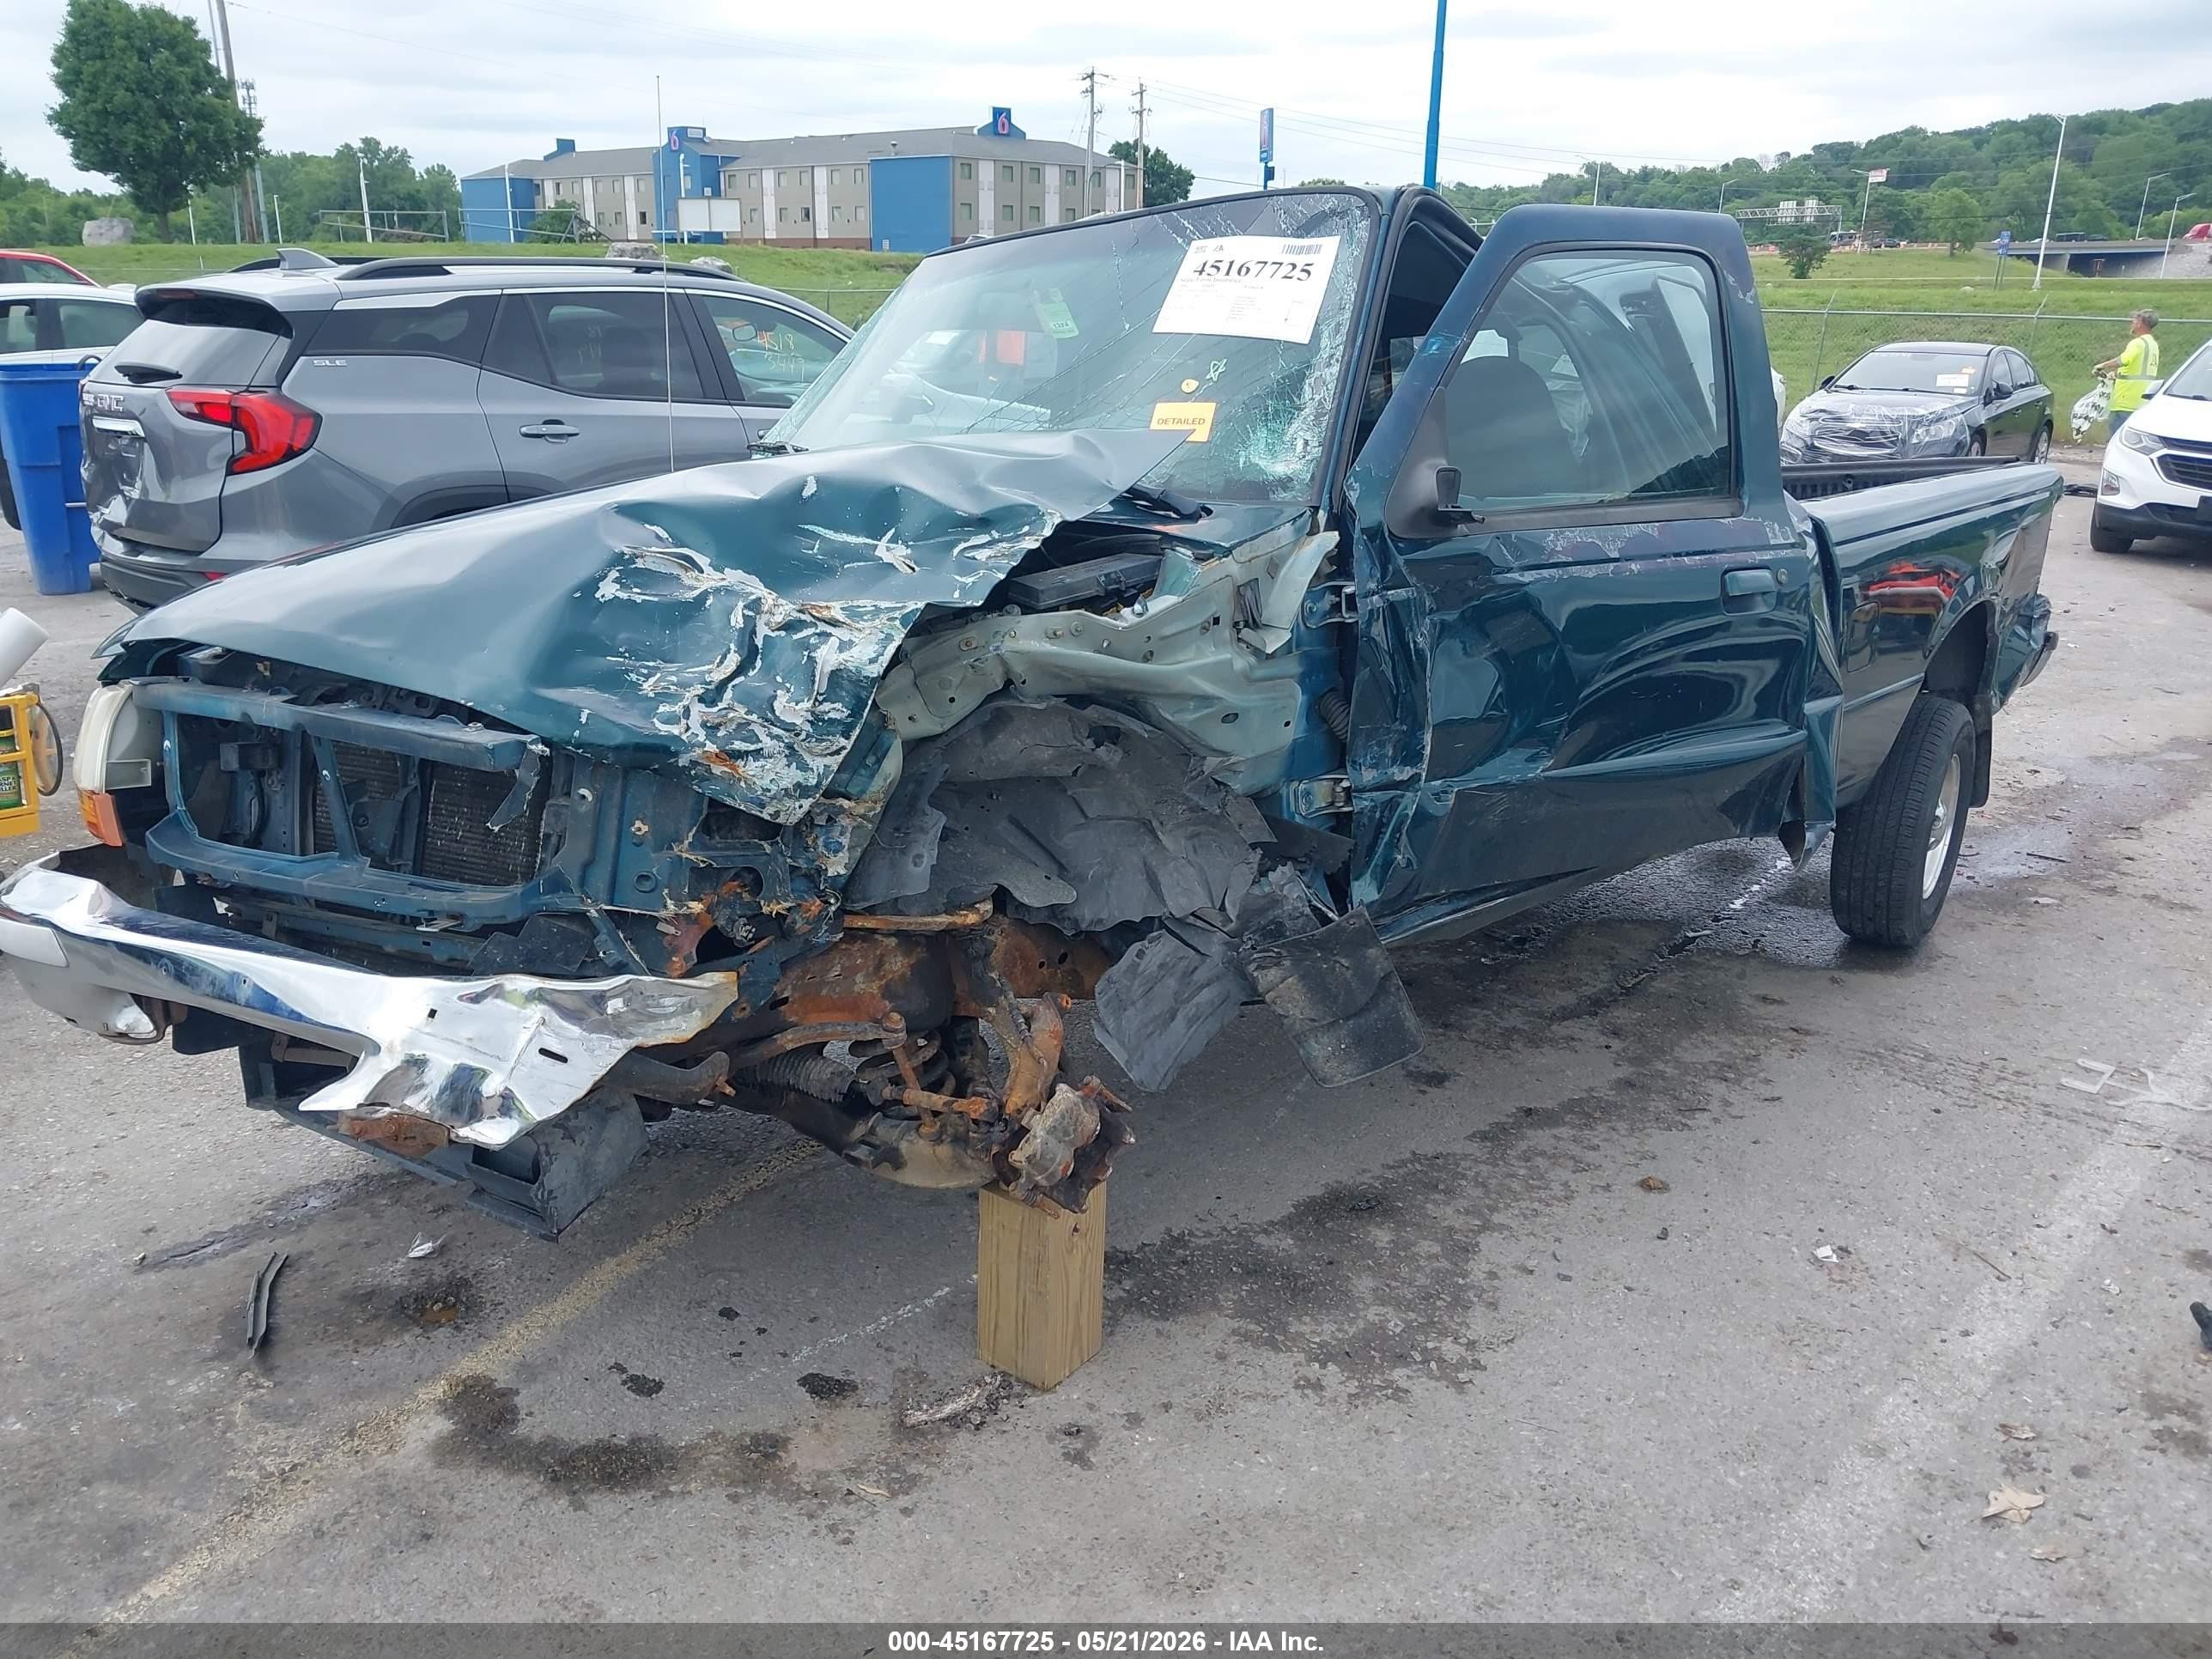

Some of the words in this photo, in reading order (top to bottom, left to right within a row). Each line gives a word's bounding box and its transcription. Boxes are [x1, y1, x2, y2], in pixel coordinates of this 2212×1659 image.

[998, 112, 1009, 134] 6
[671, 130, 679, 151] 6
[1193, 259, 1315, 282] 45167725
[757, 330, 795, 352] 4518
[1157, 417, 1206, 426] DETAILED
